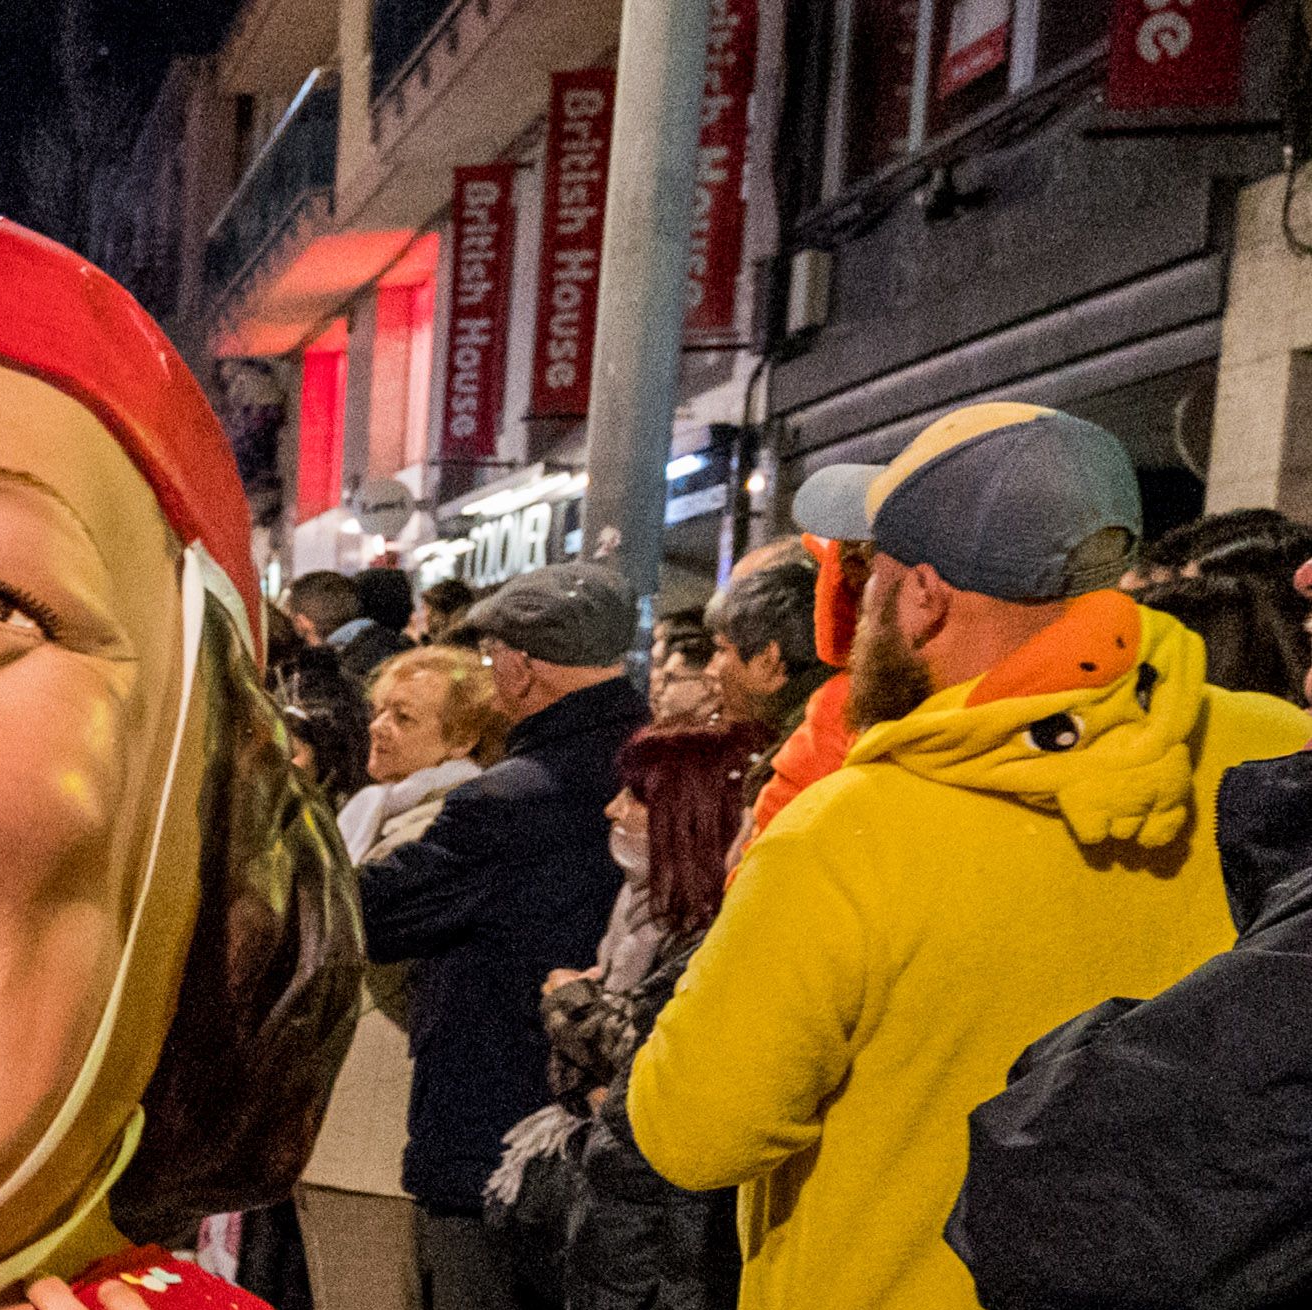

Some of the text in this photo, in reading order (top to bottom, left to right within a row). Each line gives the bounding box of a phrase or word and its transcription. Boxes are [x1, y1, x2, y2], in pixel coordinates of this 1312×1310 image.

[451, 181, 502, 438] British House
[546, 89, 605, 389] British House
